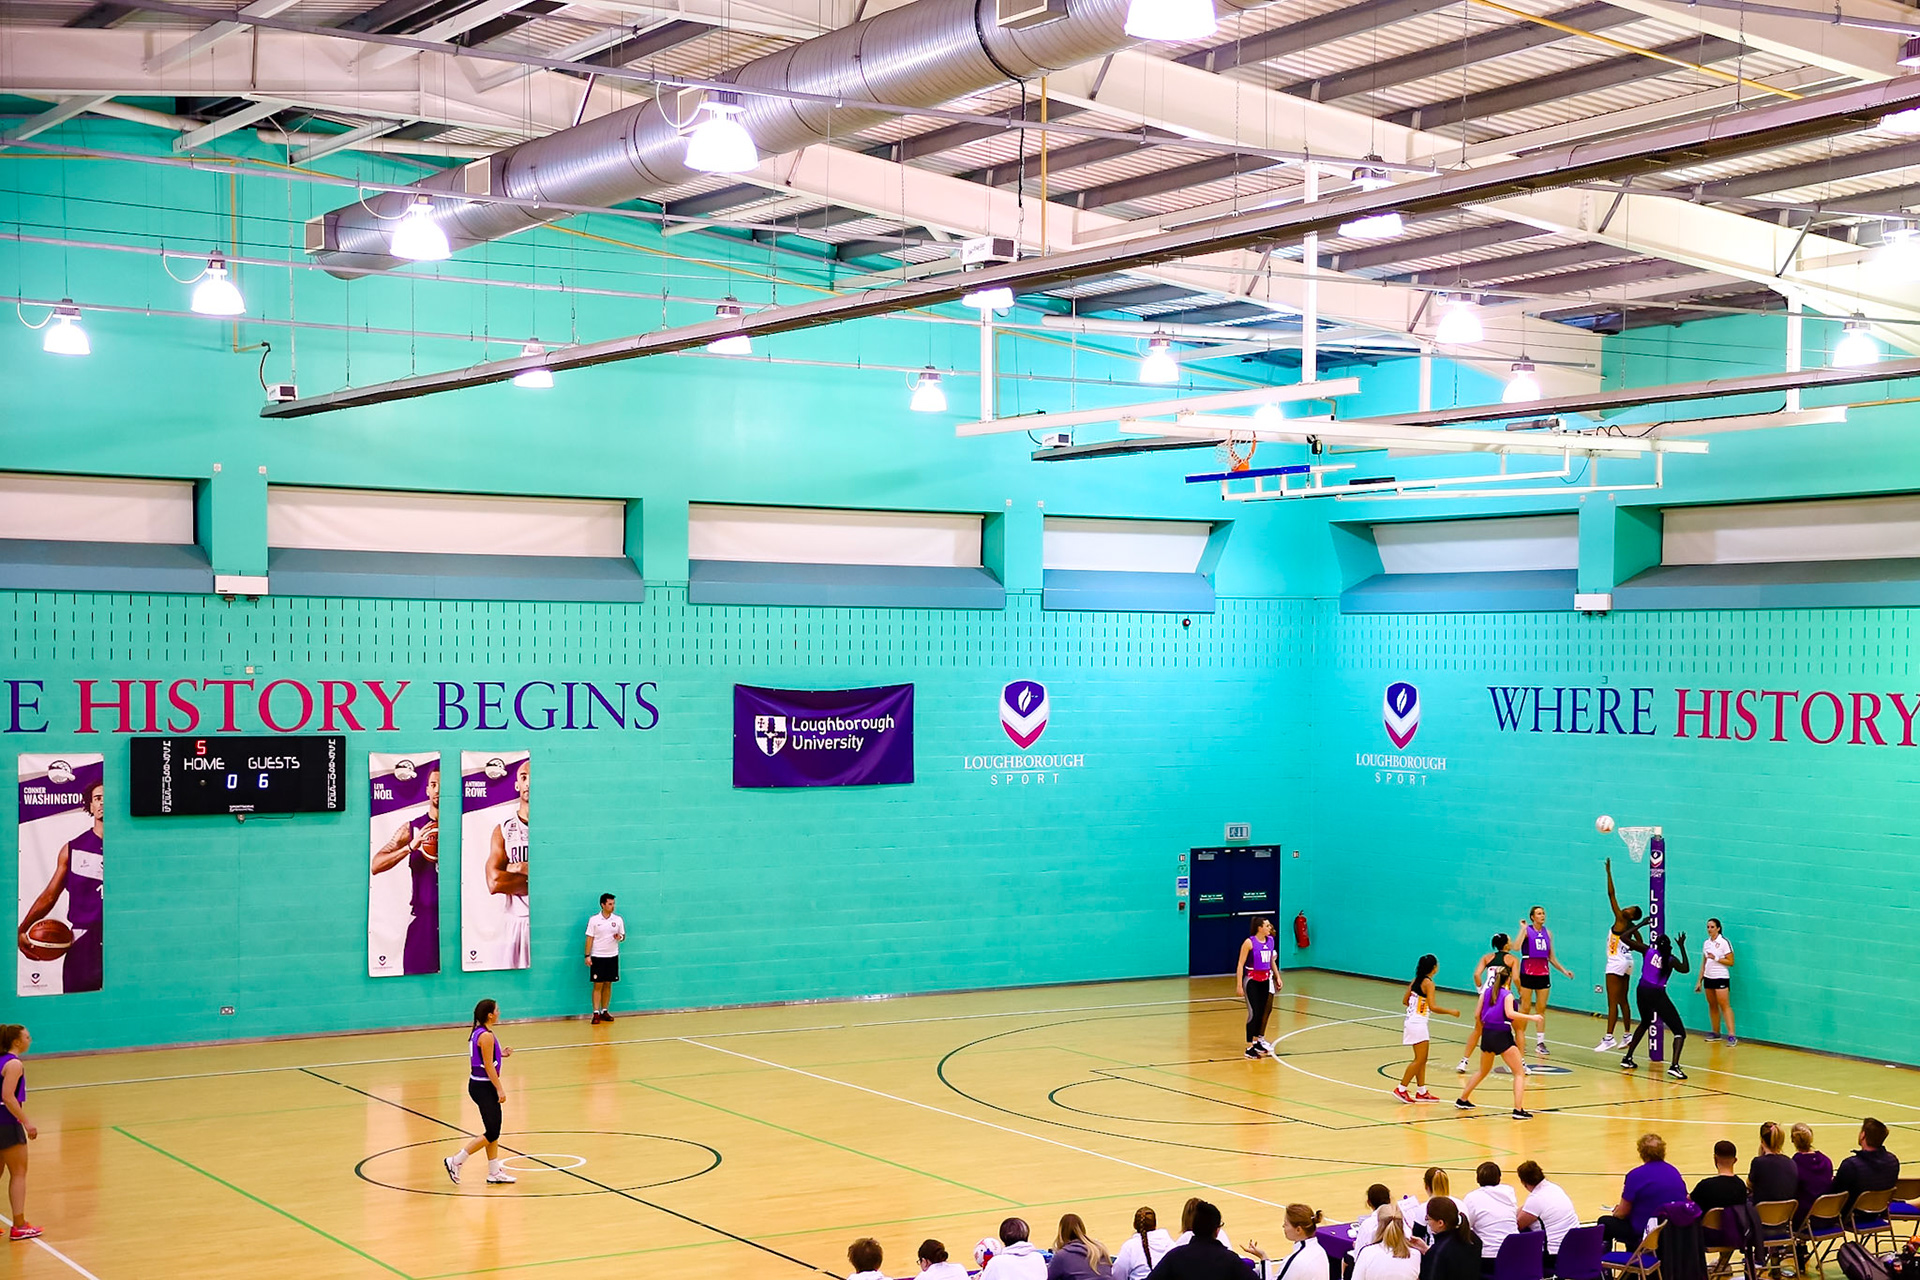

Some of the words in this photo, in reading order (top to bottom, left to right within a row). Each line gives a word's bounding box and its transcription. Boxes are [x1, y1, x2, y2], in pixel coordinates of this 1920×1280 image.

[3, 679, 49, 733] E
[73, 678, 411, 733] HISTORY
[433, 681, 660, 731] BEGINS
[1487, 686, 1657, 736] WHERE
[1673, 688, 1920, 747] HISTORY
[791, 714, 895, 735] Loughborough
[196, 740, 207, 755] 5
[792, 734, 864, 752] University
[184, 757, 225, 770] HOME
[248, 756, 300, 769] GUESTS
[964, 754, 1084, 769] LOUGHBOROUGH
[1356, 753, 1446, 770] LOUGHBOROUGH
[227, 774, 238, 789] 0
[258, 773, 269, 788] 6
[990, 773, 1059, 785] SPORT
[1375, 772, 1427, 786] SPORT
[373, 789, 394, 800] NOEL
[465, 787, 488, 798] ROWE
[1535, 938, 1547, 951] GA
